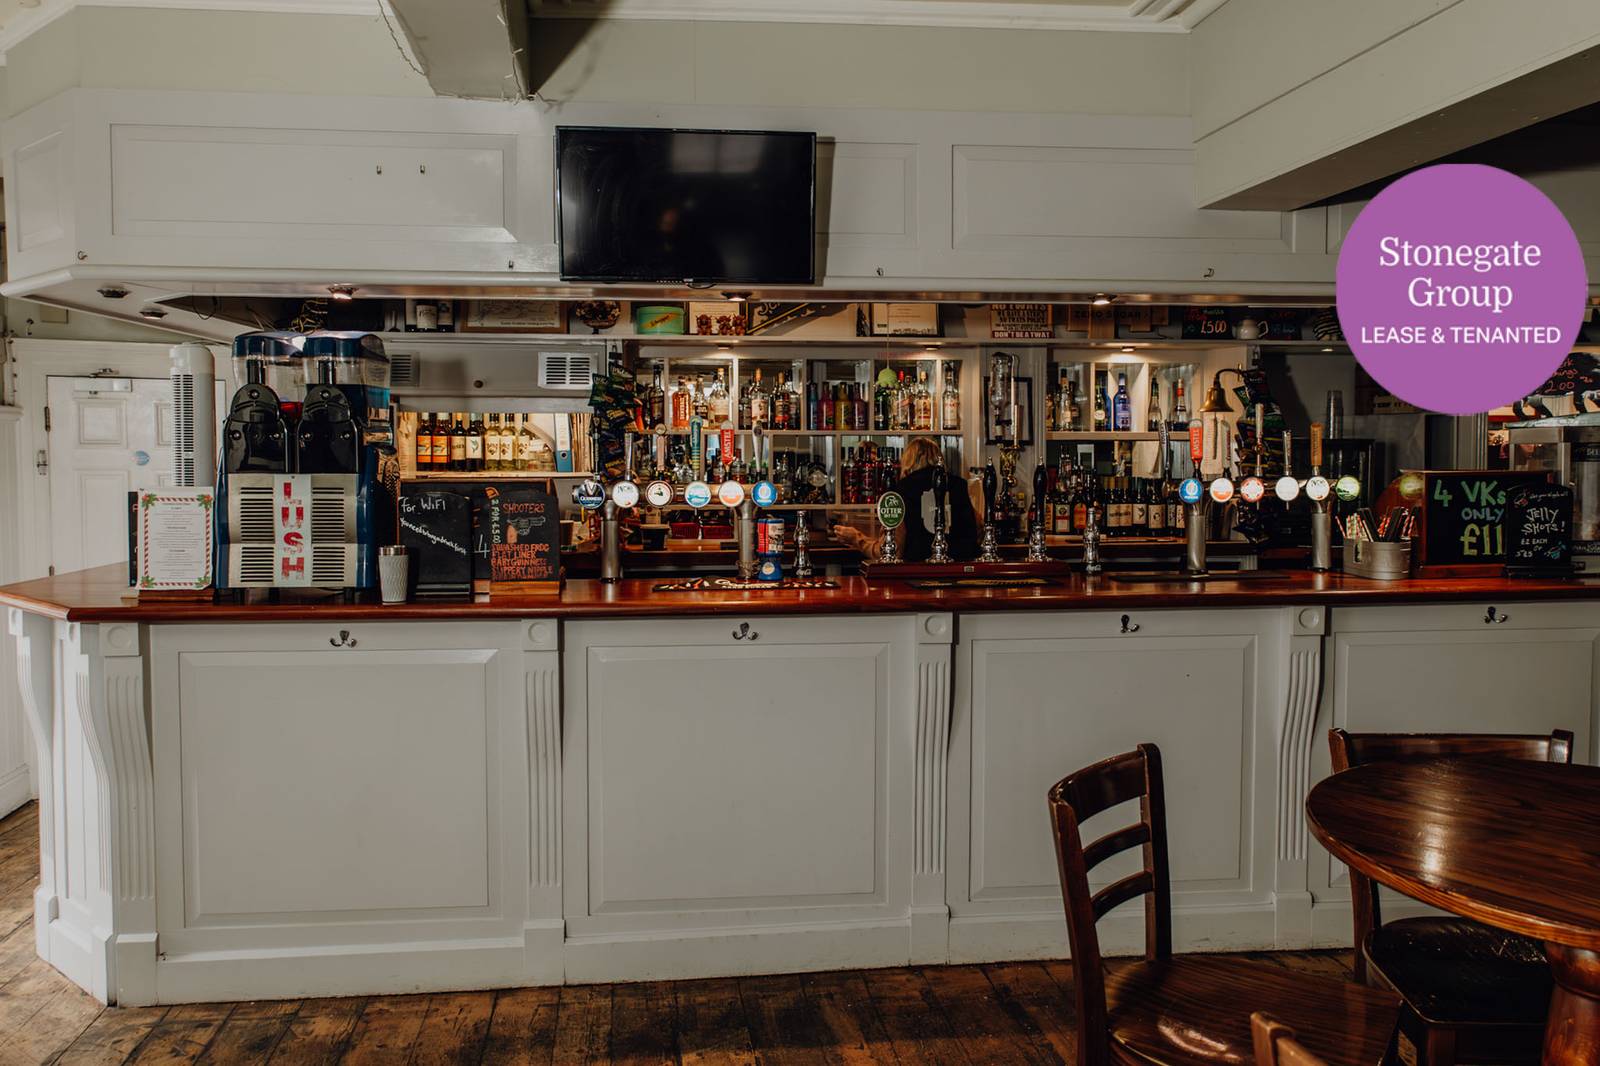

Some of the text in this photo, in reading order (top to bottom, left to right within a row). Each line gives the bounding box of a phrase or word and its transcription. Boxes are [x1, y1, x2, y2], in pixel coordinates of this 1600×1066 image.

[724, 431, 732, 459] AMSTEL
[1433, 479, 1506, 507] 4 VKs
[503, 503, 545, 514] SHOOTERS
[1461, 507, 1505, 523] ONLY
[531, 543, 550, 552] FROG
[1460, 523, 1505, 556] £11
[514, 552, 536, 560] LINER
